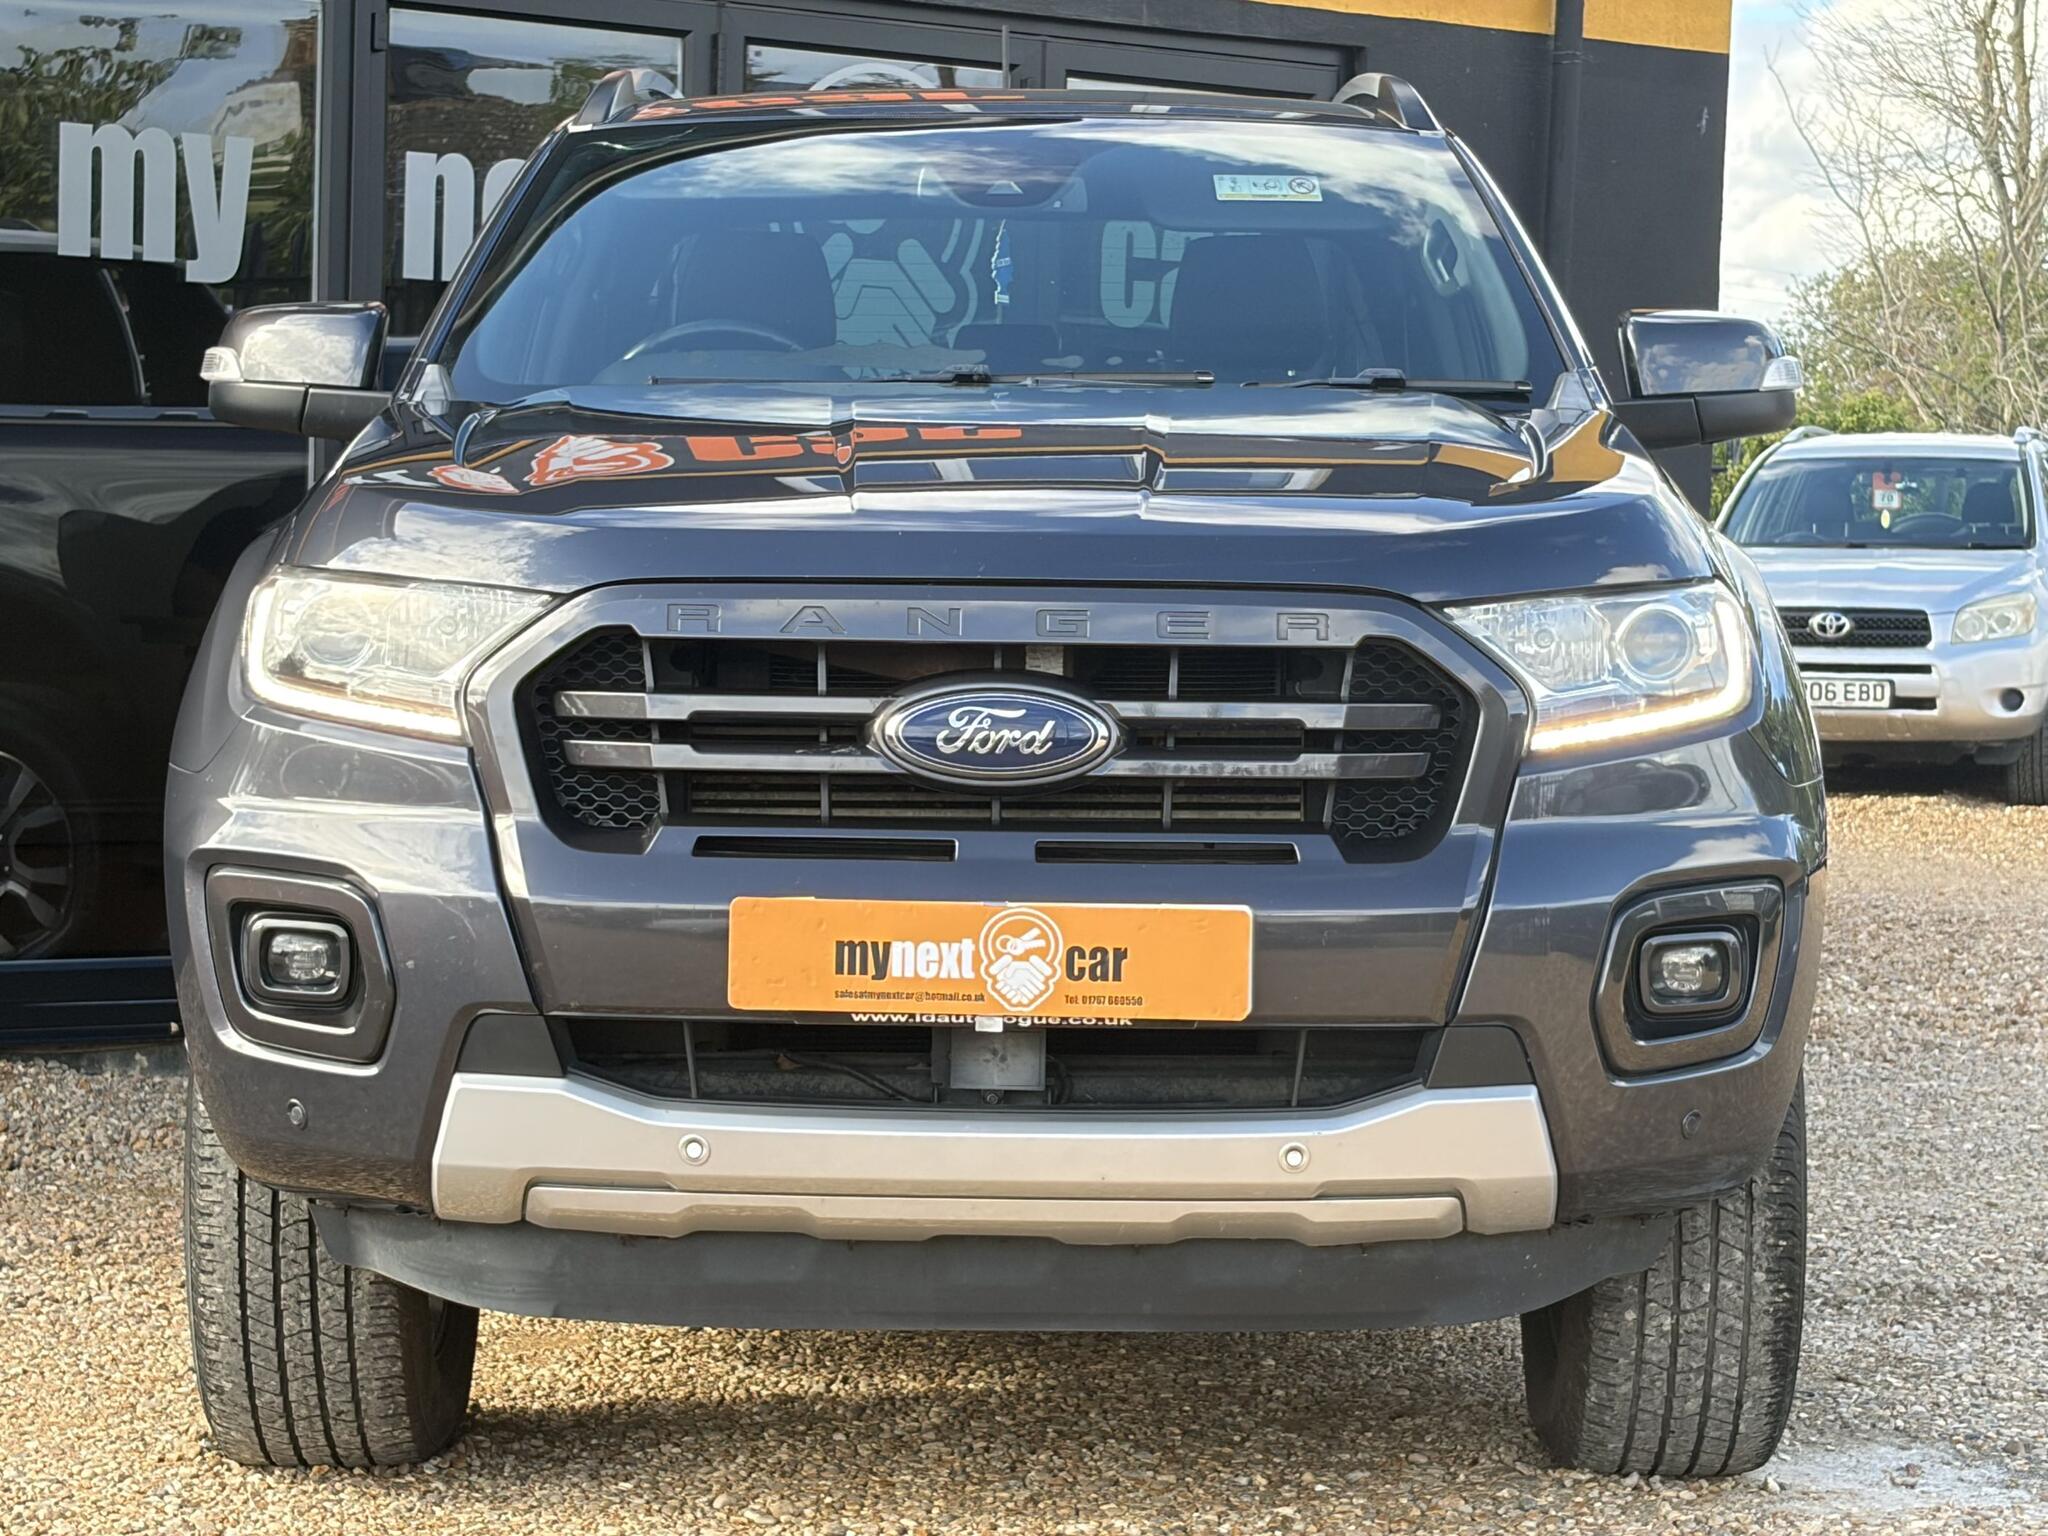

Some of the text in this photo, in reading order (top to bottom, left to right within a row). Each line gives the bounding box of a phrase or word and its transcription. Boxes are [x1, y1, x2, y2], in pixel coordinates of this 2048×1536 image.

[58, 122, 253, 283] my
[666, 603, 1330, 642] RANGER
[1804, 682, 1885, 702] 06 EBD
[936, 706, 1055, 755] Ford
[834, 938, 1128, 982] mynext car
